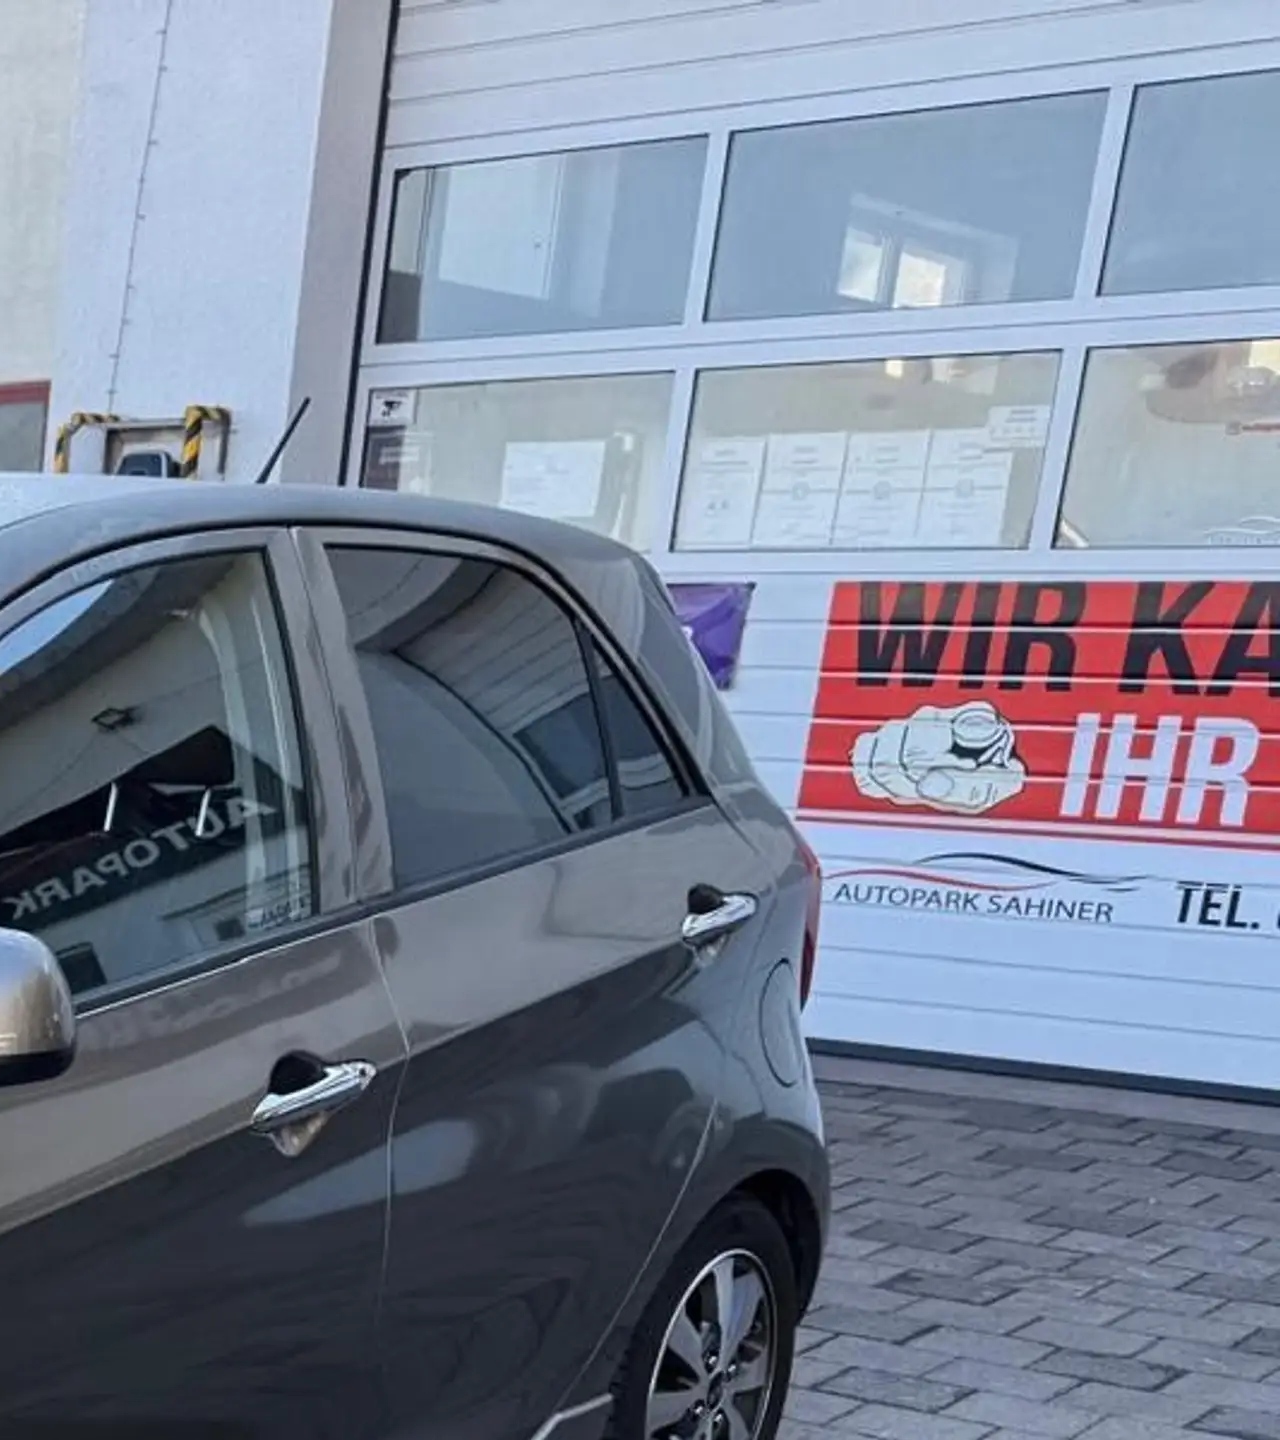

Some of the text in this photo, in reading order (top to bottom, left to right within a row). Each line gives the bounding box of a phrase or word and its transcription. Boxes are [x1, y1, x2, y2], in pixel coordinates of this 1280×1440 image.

[856, 582, 1280, 697] WIR KA
[1059, 713, 1259, 827] IHR
[834, 883, 1114, 923] AUTOPARK SAHINER
[1176, 881, 1260, 929] TEL.
